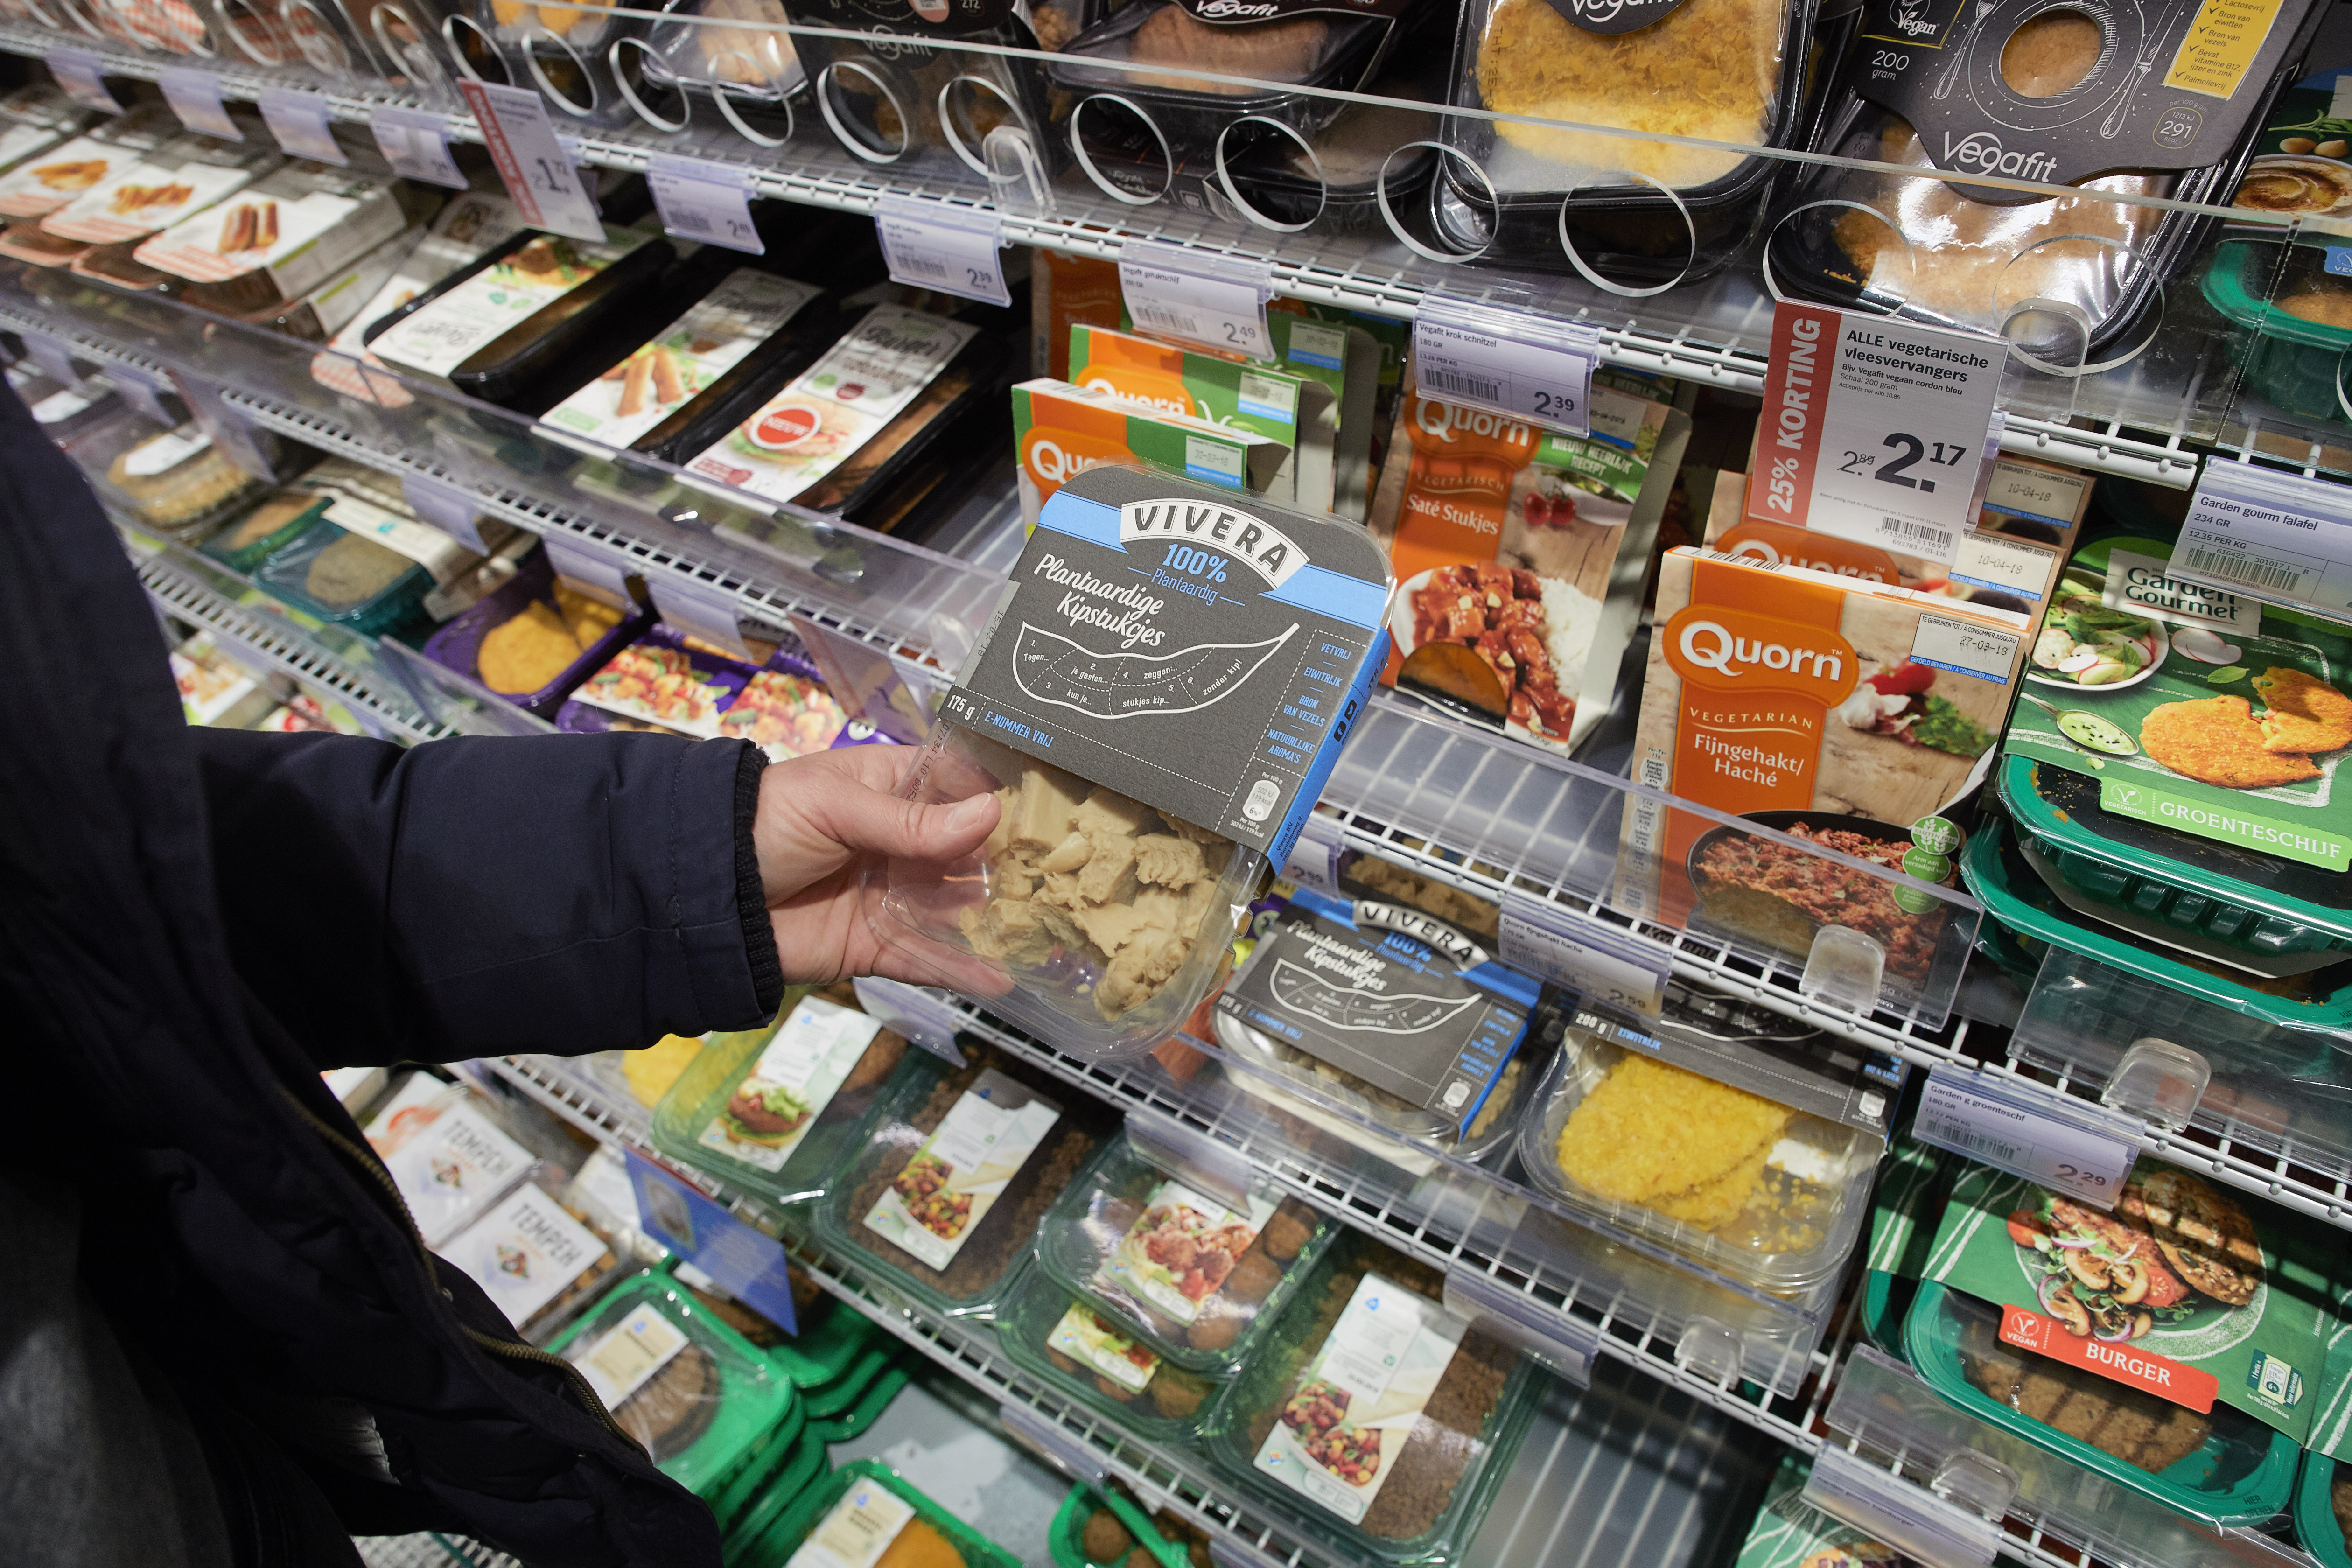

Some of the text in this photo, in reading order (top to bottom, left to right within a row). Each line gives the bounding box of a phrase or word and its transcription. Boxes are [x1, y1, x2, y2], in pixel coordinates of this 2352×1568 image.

[1897, 9, 1936, 36] Vegan
[2214, 19, 2243, 29] eiwitten
[2218, 11, 2236, 19] Bron
[2205, 38, 2227, 47] vezels
[2208, 30, 2226, 38] Bron
[1872, 50, 1909, 70] 200
[2198, 49, 2219, 58] Bevat
[2195, 57, 2240, 71] vitamine B12,
[2217, 70, 2233, 78] zink
[1872, 69, 1896, 80] gram
[2184, 75, 2227, 90] Palmolievrij
[2160, 120, 2193, 139] 291
[1944, 131, 2057, 183] Vegafit
[1223, 322, 1256, 346] 2.49
[1419, 323, 1497, 348] Vegafit krok schnitzel
[1847, 330, 1988, 368] ALLE vegetarische
[1845, 347, 1968, 382] vleesvervangers
[1841, 373, 1898, 391] Schaal 200 gram
[1842, 363, 1963, 395] Bijv. Vegafit vegaan cordon bleu
[1839, 382, 1863, 393] Actieprijs
[1886, 392, 1901, 400] 10.85
[1533, 391, 1575, 418] 2.39
[1767, 317, 1821, 514] 25% KORTING
[1552, 436, 1587, 455] NIEUW
[1571, 454, 1608, 478] RECEPT
[1837, 432, 1967, 494] 2.89 2.17
[2008, 483, 2051, 502] 10-04-18
[1406, 493, 1500, 536] Saté Stukjes
[2194, 513, 2231, 528] 234 GR
[2200, 497, 2319, 531] Garden gourm falafel
[1134, 505, 1289, 577] VIVERA
[1892, 539, 1947, 558] 693783 01-116
[2189, 530, 2247, 550] 12.35 PER KG
[1162, 543, 1229, 583] 100%
[1978, 555, 2023, 575] 10-04-18
[2217, 548, 2285, 569] 616422 301017
[1033, 553, 1165, 622] Plantaardige
[1151, 567, 1218, 607] Plantaardig
[2125, 585, 2239, 621] Gourmet
[1928, 617, 1952, 628] GEBRUIKEN
[1968, 627, 1995, 638] CONSOMMER
[1995, 634, 2016, 644] JUSQU'AU
[1023, 653, 1050, 663] Tegen...
[1320, 642, 1352, 660] VETVRIJ
[1680, 620, 1842, 681] Quorn
[1071, 666, 1109, 685] je gasten...
[1202, 658, 1243, 696] zonder kip!
[1303, 666, 1343, 688] EIWITRIJK
[1911, 656, 1931, 666] GEKOELD
[1931, 661, 1952, 671] BEWAREN
[1960, 668, 1985, 679] CONSERVER
[946, 693, 976, 721] 175 g
[1066, 688, 1092, 706] kun je...
[1122, 695, 1171, 708] stukjes kip...
[1298, 694, 1319, 710] BRON
[1283, 704, 1326, 728] VAN VEZELS
[1690, 707, 1812, 729] VEGETARIAN
[984, 710, 1055, 749] E-NUMMER VRIJ
[1267, 728, 1316, 755] NATUURLIJKE
[1267, 744, 1302, 764] AROMA'S
[1694, 733, 1805, 776] Fijngehakt/
[1270, 775, 1279, 783] 100
[1714, 757, 1778, 787] Haché
[1252, 793, 1274, 806] 119 kcal
[1256, 786, 1268, 795] 502
[2104, 800, 2147, 816] VEGETARISCH
[1247, 819, 1256, 828] 100
[2160, 801, 2342, 859] GROENTESCHIJF
[1915, 828, 1955, 843] GLUTEN FREE
[1905, 860, 1936, 872] verzadigd
[1913, 855, 1926, 863] Arm
[1365, 906, 1473, 962] VIVERA
[1286, 919, 1388, 974] Plantaardige
[1383, 931, 1433, 962] 100%
[1575, 1012, 1598, 1029] 200
[1928, 1096, 1957, 1111] 180 GR
[1931, 1085, 2026, 1122] Garden groenteschf
[2054, 1163, 2107, 1187] 2.29
[2006, 1331, 2037, 1348] VEGAN
[2085, 1342, 2171, 1387] BURGER
[2243, 1495, 2263, 1506] HIER
[2244, 1505, 2276, 1518] OPENEN
